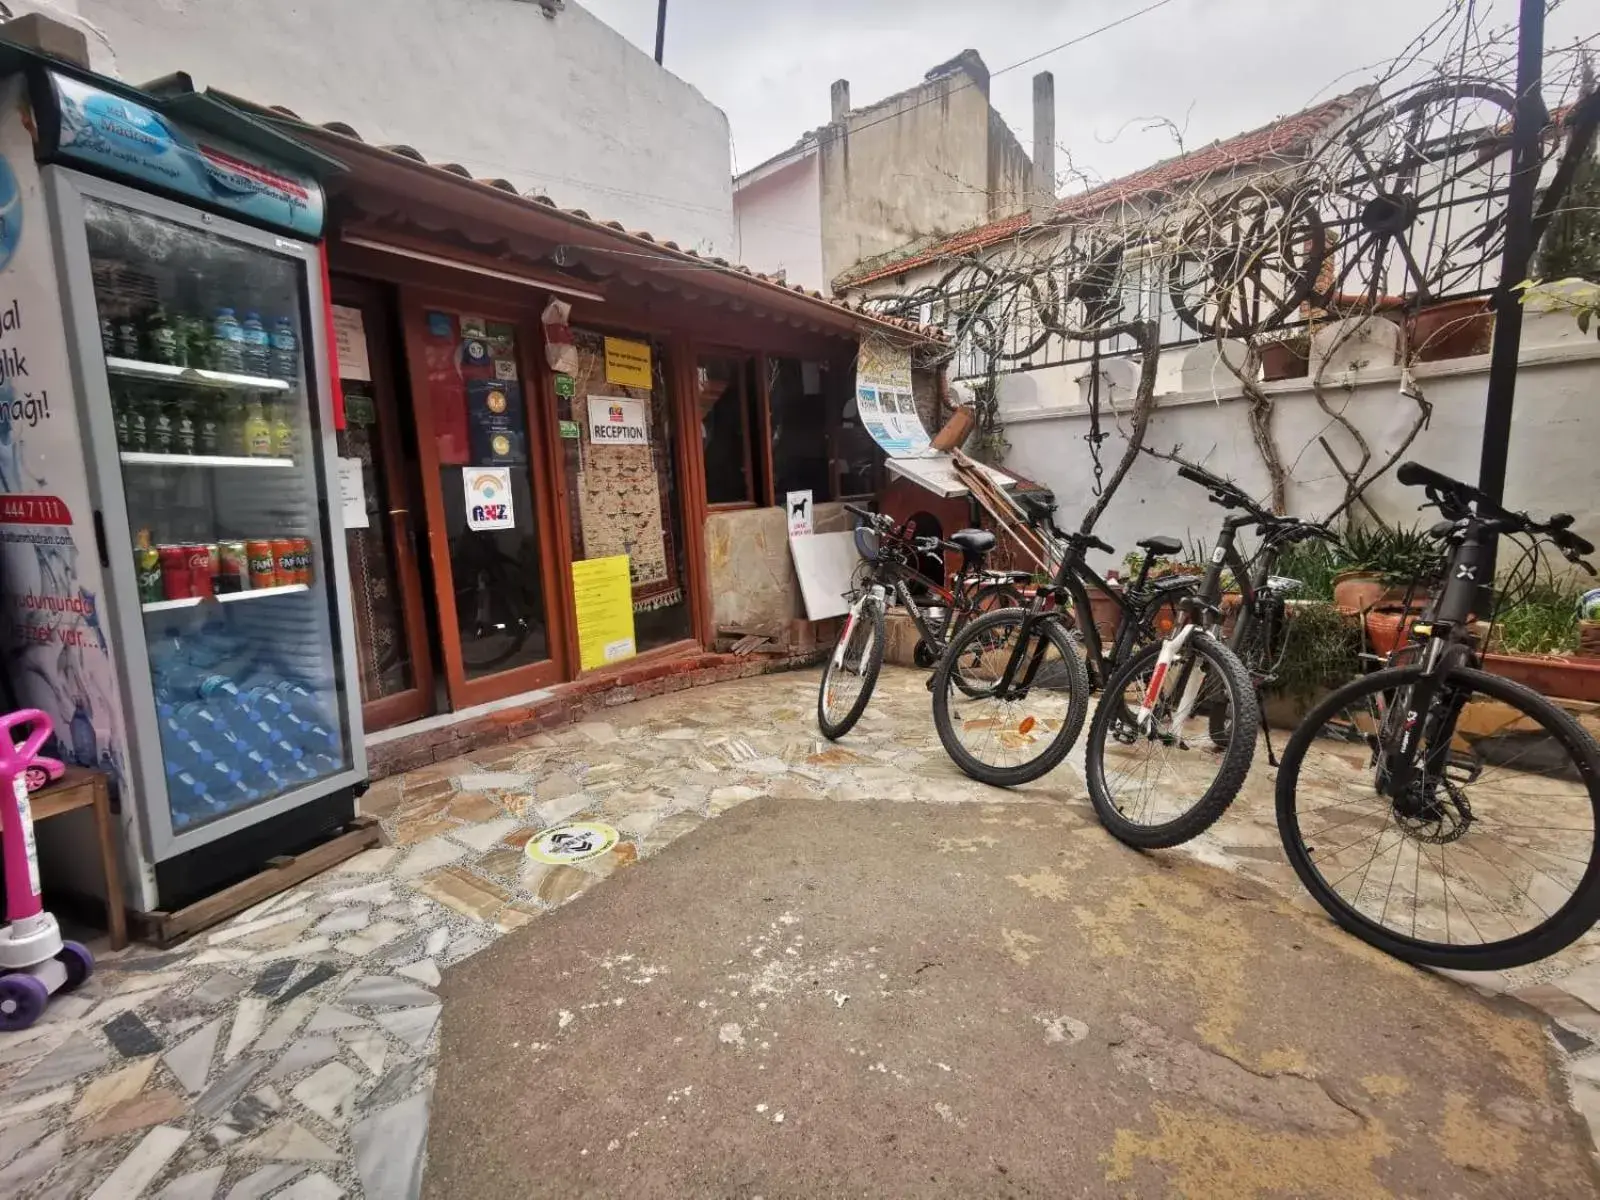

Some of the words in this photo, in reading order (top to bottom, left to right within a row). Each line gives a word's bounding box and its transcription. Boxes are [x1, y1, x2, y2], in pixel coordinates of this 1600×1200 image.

[0, 299, 21, 340] al
[594, 425, 642, 439] RECEPTION
[472, 504, 508, 522] RNZ
